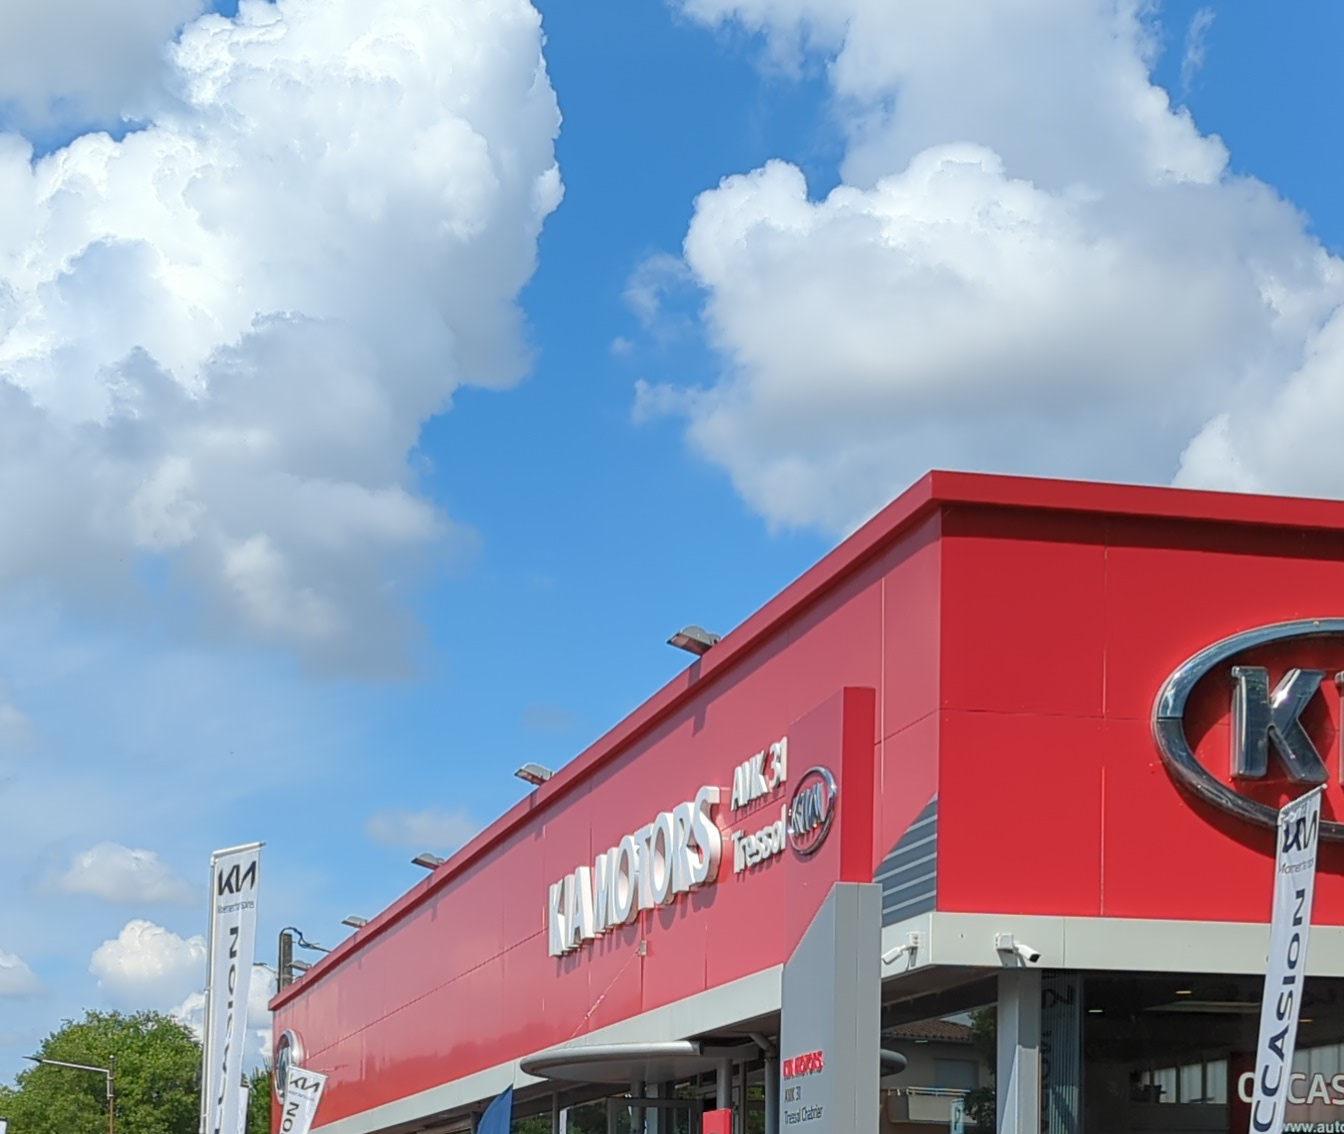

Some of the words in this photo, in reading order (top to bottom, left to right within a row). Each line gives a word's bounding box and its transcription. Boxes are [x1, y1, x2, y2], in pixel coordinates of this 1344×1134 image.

[548, 866, 595, 957] KIA
[594, 786, 722, 934] MOTORS
[732, 804, 787, 874] Tressol
